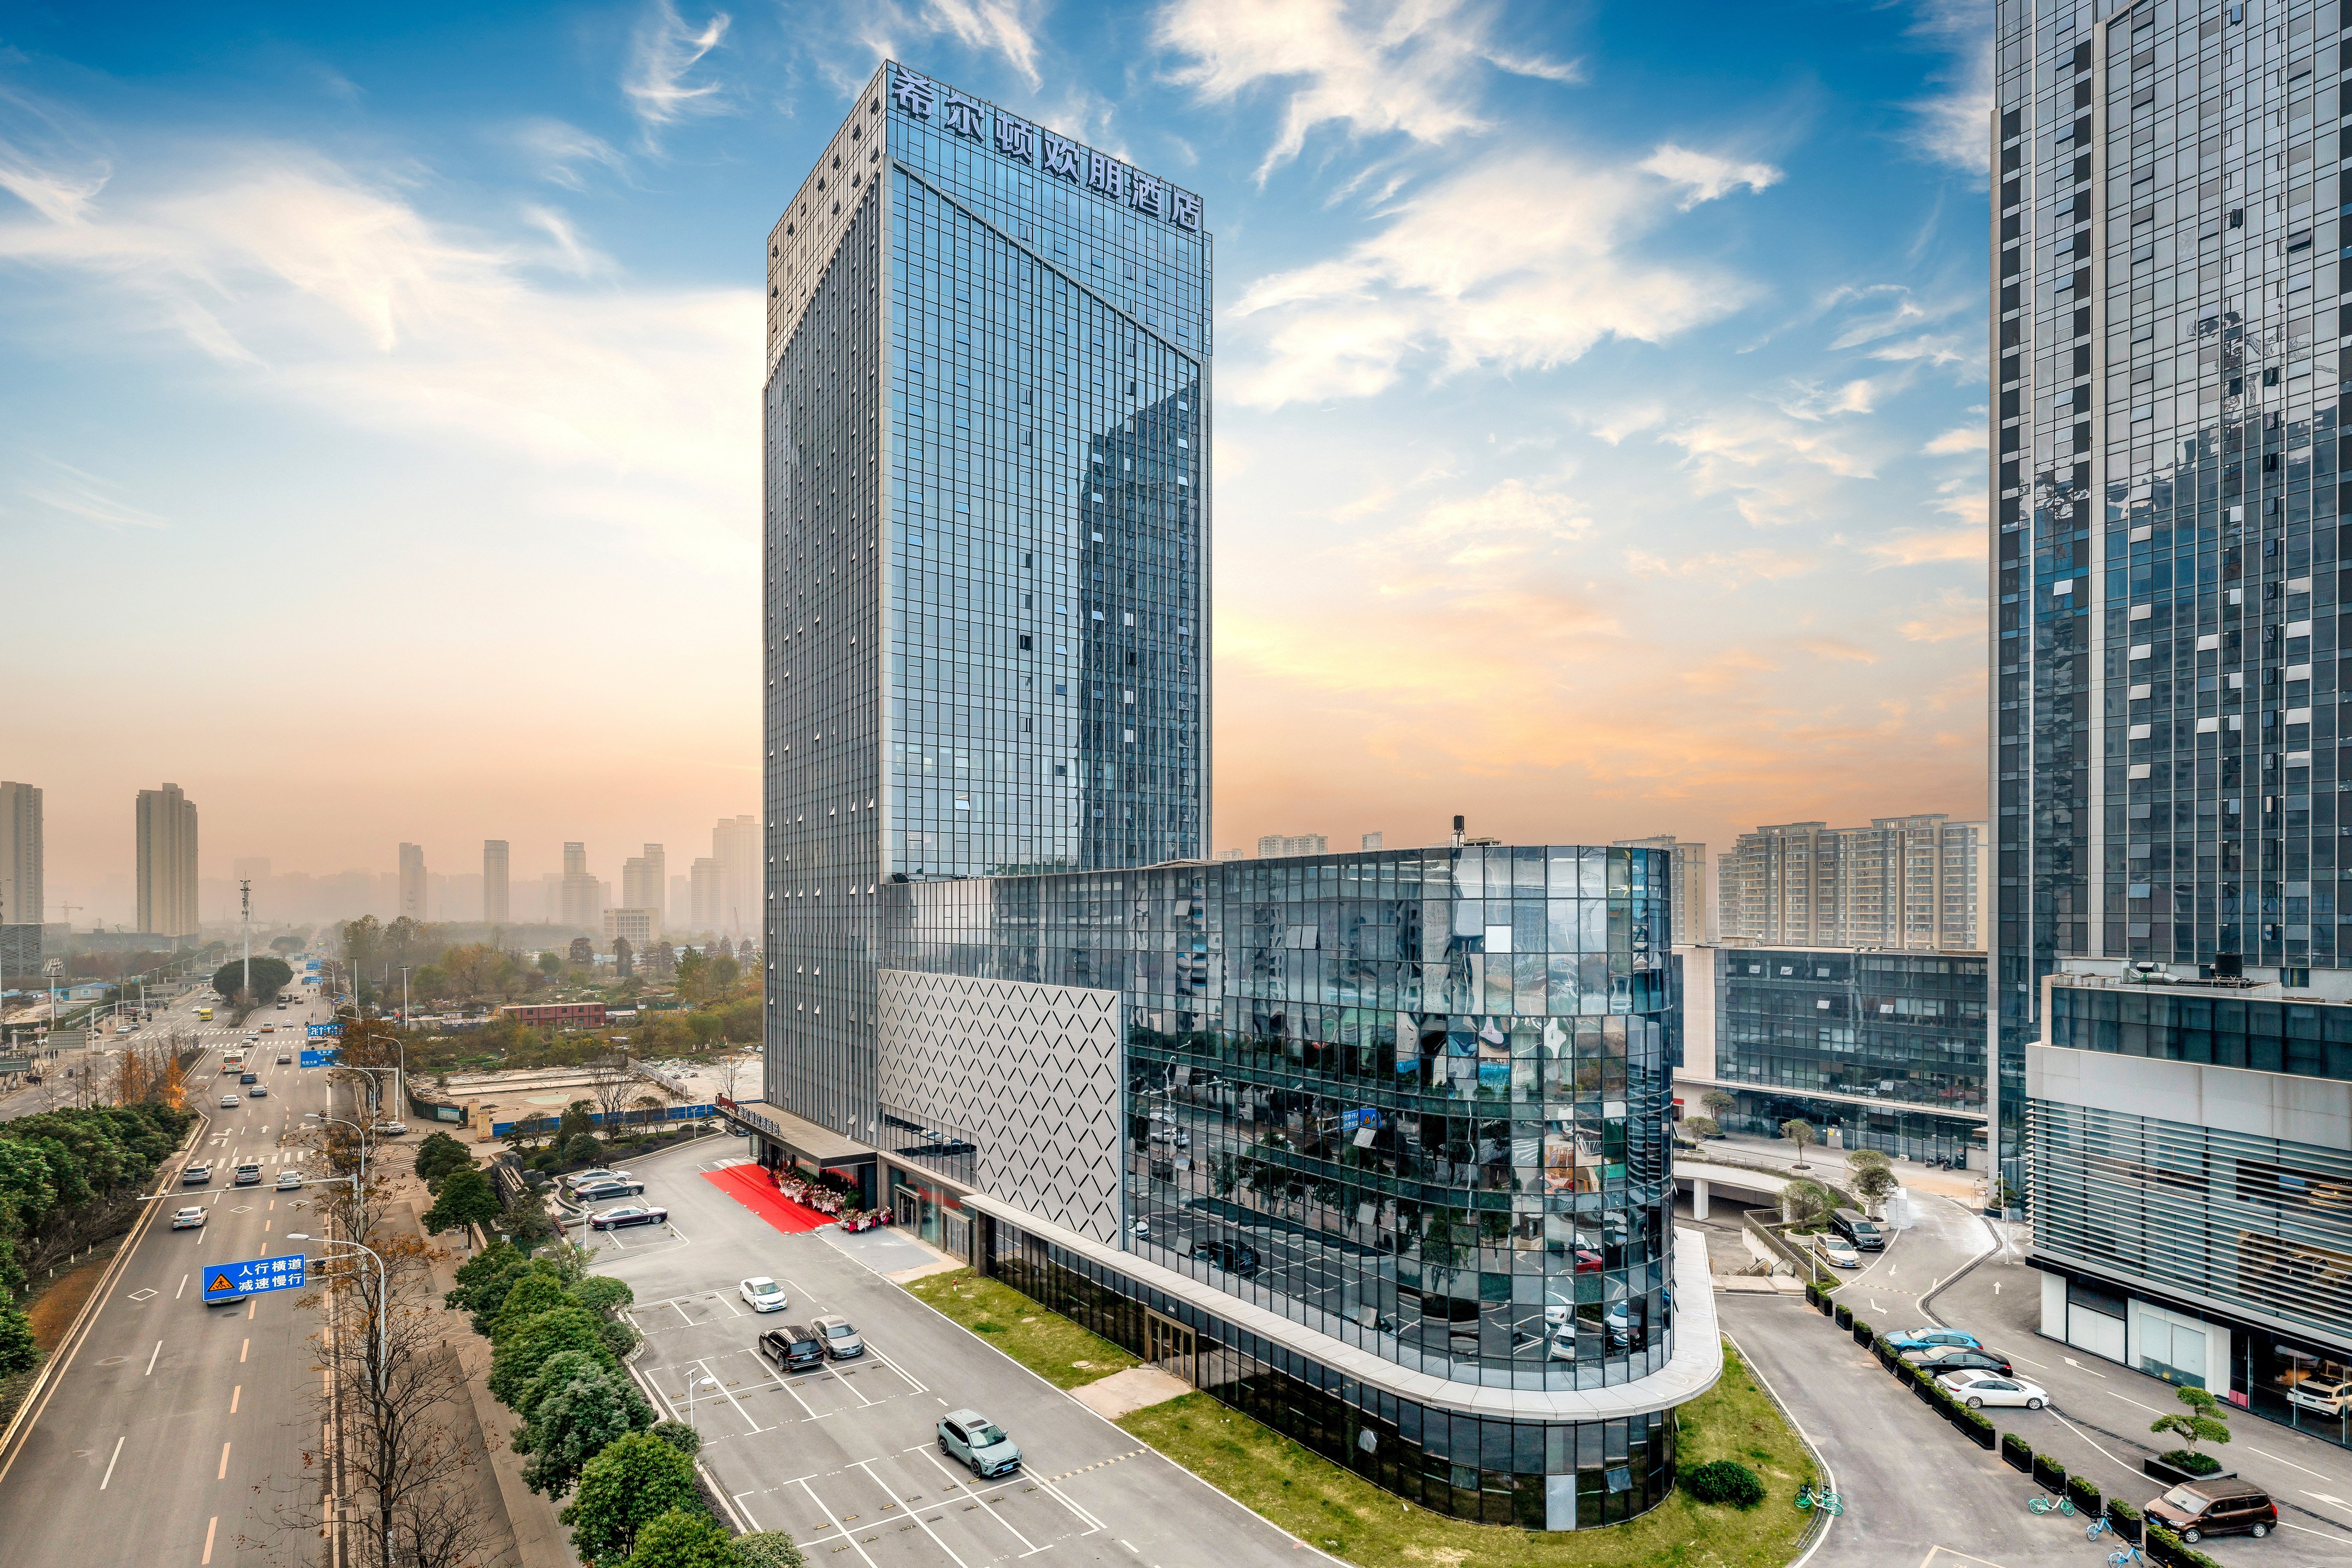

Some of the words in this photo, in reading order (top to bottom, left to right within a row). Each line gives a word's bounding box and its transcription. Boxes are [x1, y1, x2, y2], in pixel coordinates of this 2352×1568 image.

[893, 68, 1202, 232] 希尔顿欢朋酒店
[238, 1258, 302, 1277] 人行横道
[238, 1273, 302, 1292] 减速慢行
[993, 1554, 1010, 1563] 050
